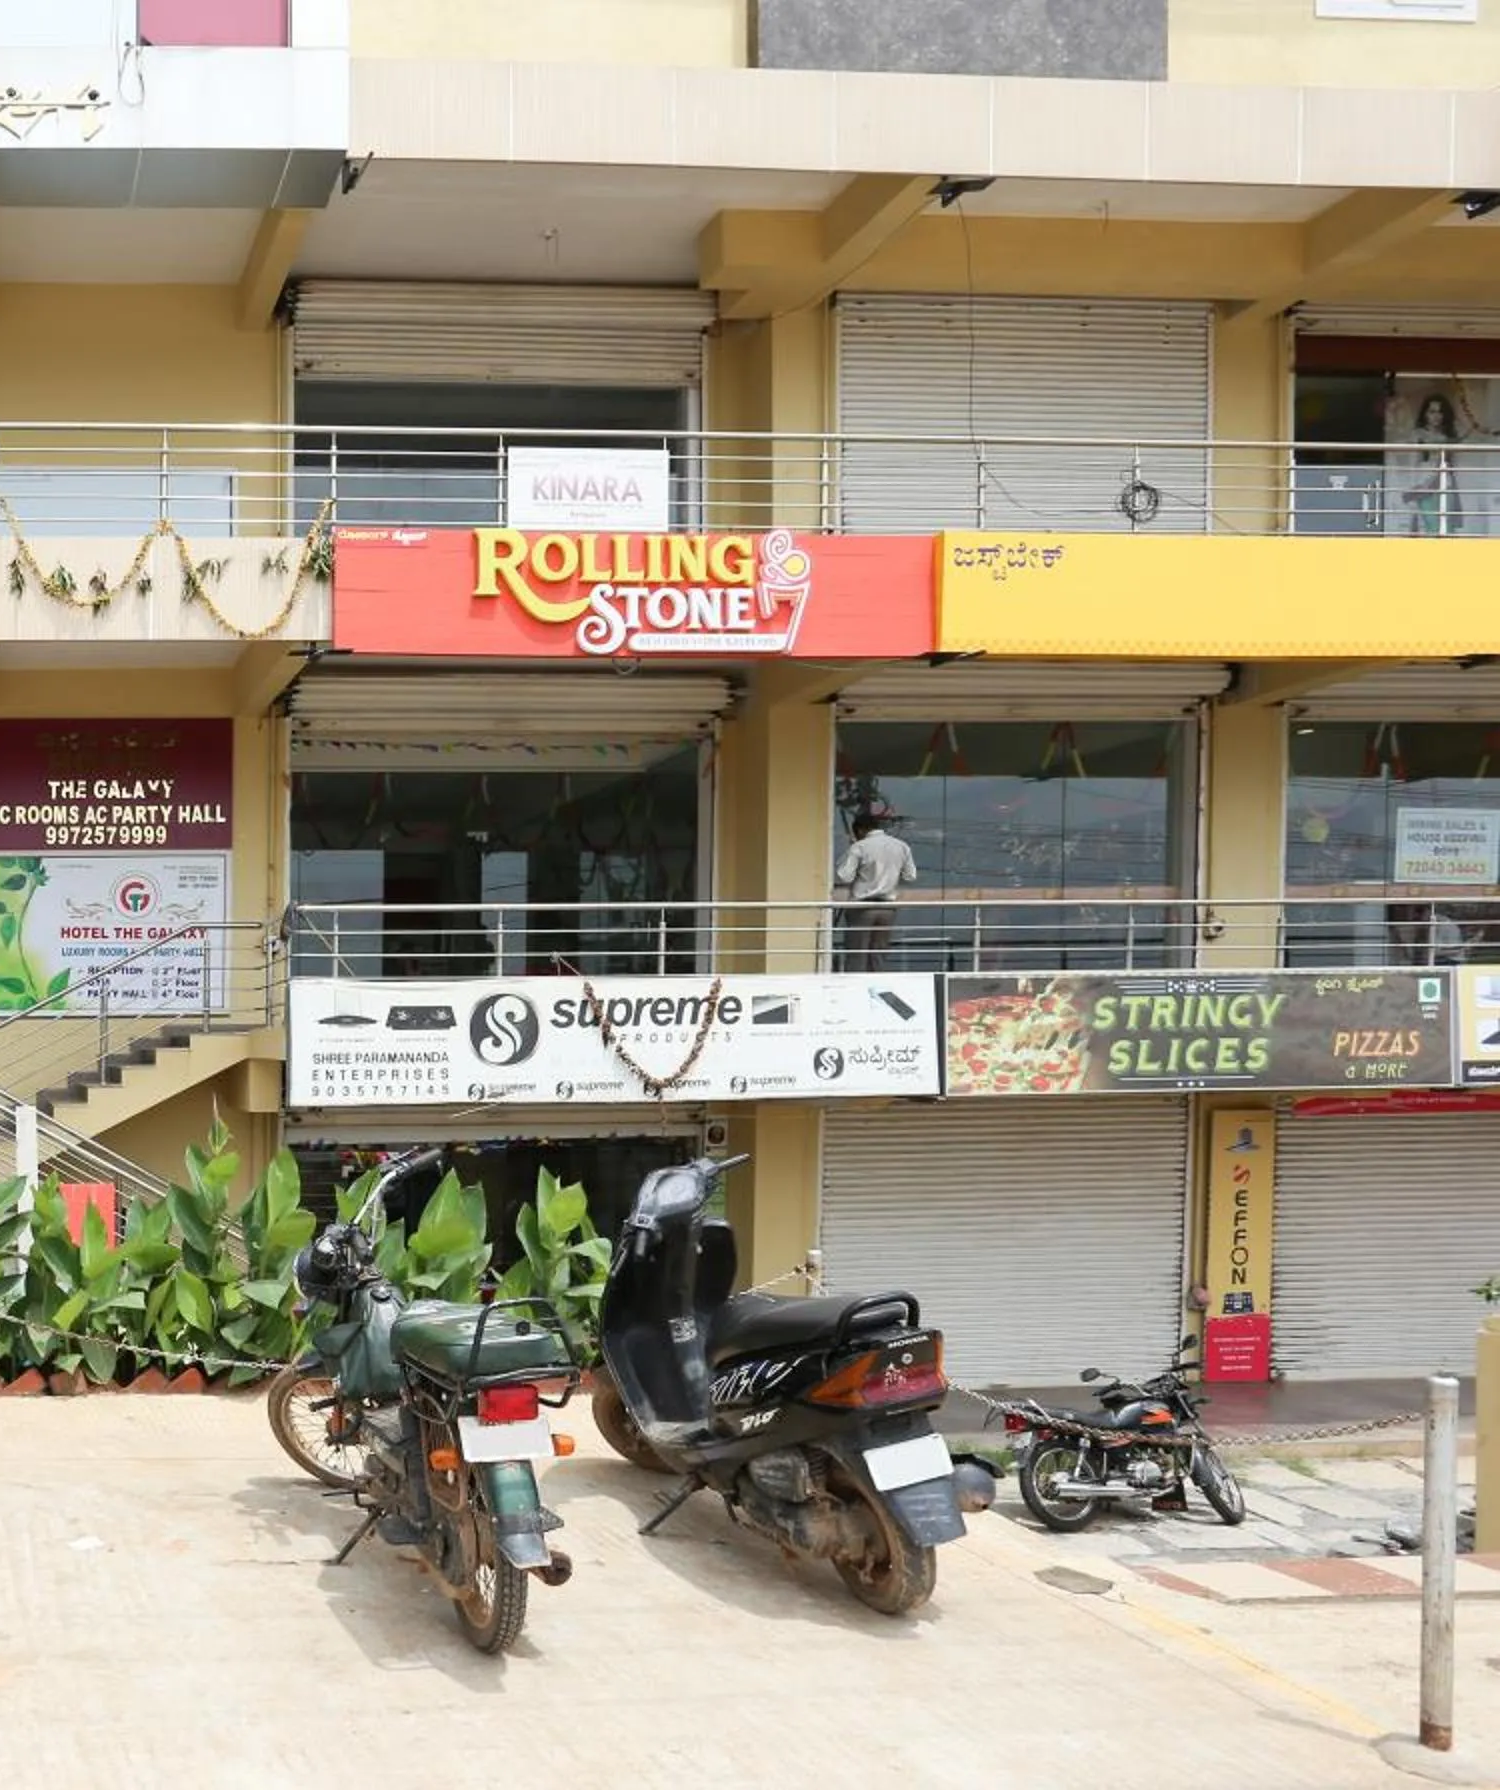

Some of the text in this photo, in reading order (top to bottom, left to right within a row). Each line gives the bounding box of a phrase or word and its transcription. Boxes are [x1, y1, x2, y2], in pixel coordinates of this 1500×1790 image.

[532, 473, 643, 503] KINARA
[471, 526, 757, 624] ROLLING
[576, 581, 758, 655] STONE
[48, 780, 87, 799] THE
[15, 805, 79, 825] ROOMS
[83, 805, 110, 825] AC
[112, 804, 172, 824] PARTY
[178, 804, 227, 823] HALL
[45, 825, 167, 845] 9972579999
[60, 927, 108, 939] HOTEL
[114, 927, 142, 939] THE
[87, 967, 143, 975] REEPTION
[550, 994, 743, 1029] supreme
[1092, 993, 1287, 1031] STRINGY
[618, 1031, 733, 1044] PRODUTS
[1333, 1030, 1421, 1057] PIZZAS
[312, 1051, 450, 1065] SHREE PARAMANANDA
[1107, 1036, 1272, 1074] SLICES
[311, 1068, 450, 1081] ENTERPRISES
[666, 1077, 711, 1090] upreme
